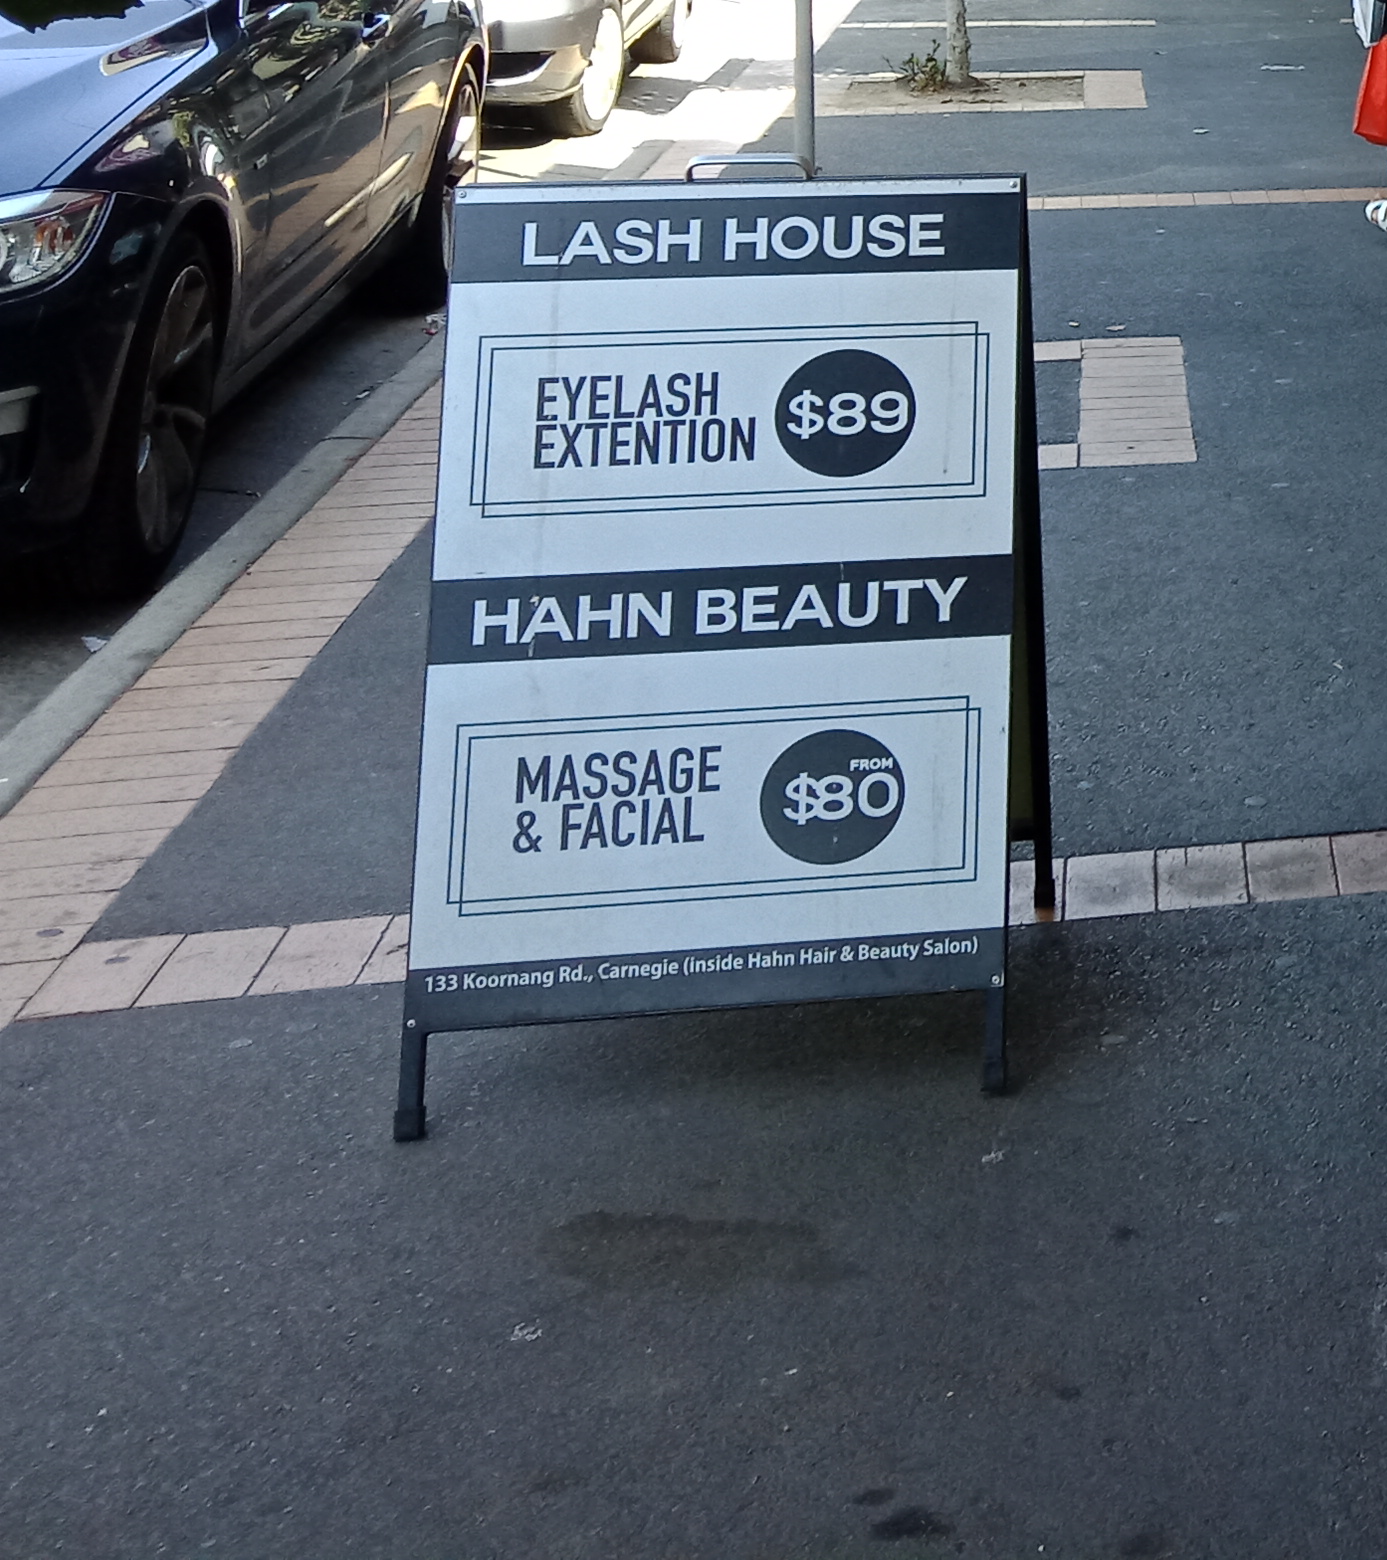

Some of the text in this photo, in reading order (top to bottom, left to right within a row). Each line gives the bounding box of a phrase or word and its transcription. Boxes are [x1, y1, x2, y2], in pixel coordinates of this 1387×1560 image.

[521, 212, 946, 267] LASH HOUSE
[536, 371, 720, 422] EYELASH
[786, 388, 910, 441] $89
[533, 416, 758, 470] EXTENTION
[471, 576, 969, 647] HAHN BEAUTY
[514, 745, 723, 804] MASSAGE
[848, 755, 895, 772] FROM
[511, 796, 705, 854] & FACIAL
[782, 771, 899, 826] $80
[424, 935, 980, 994] 133 Koornang Rd., Carnegie (inside Hahn Hair & Beauty Salon)
